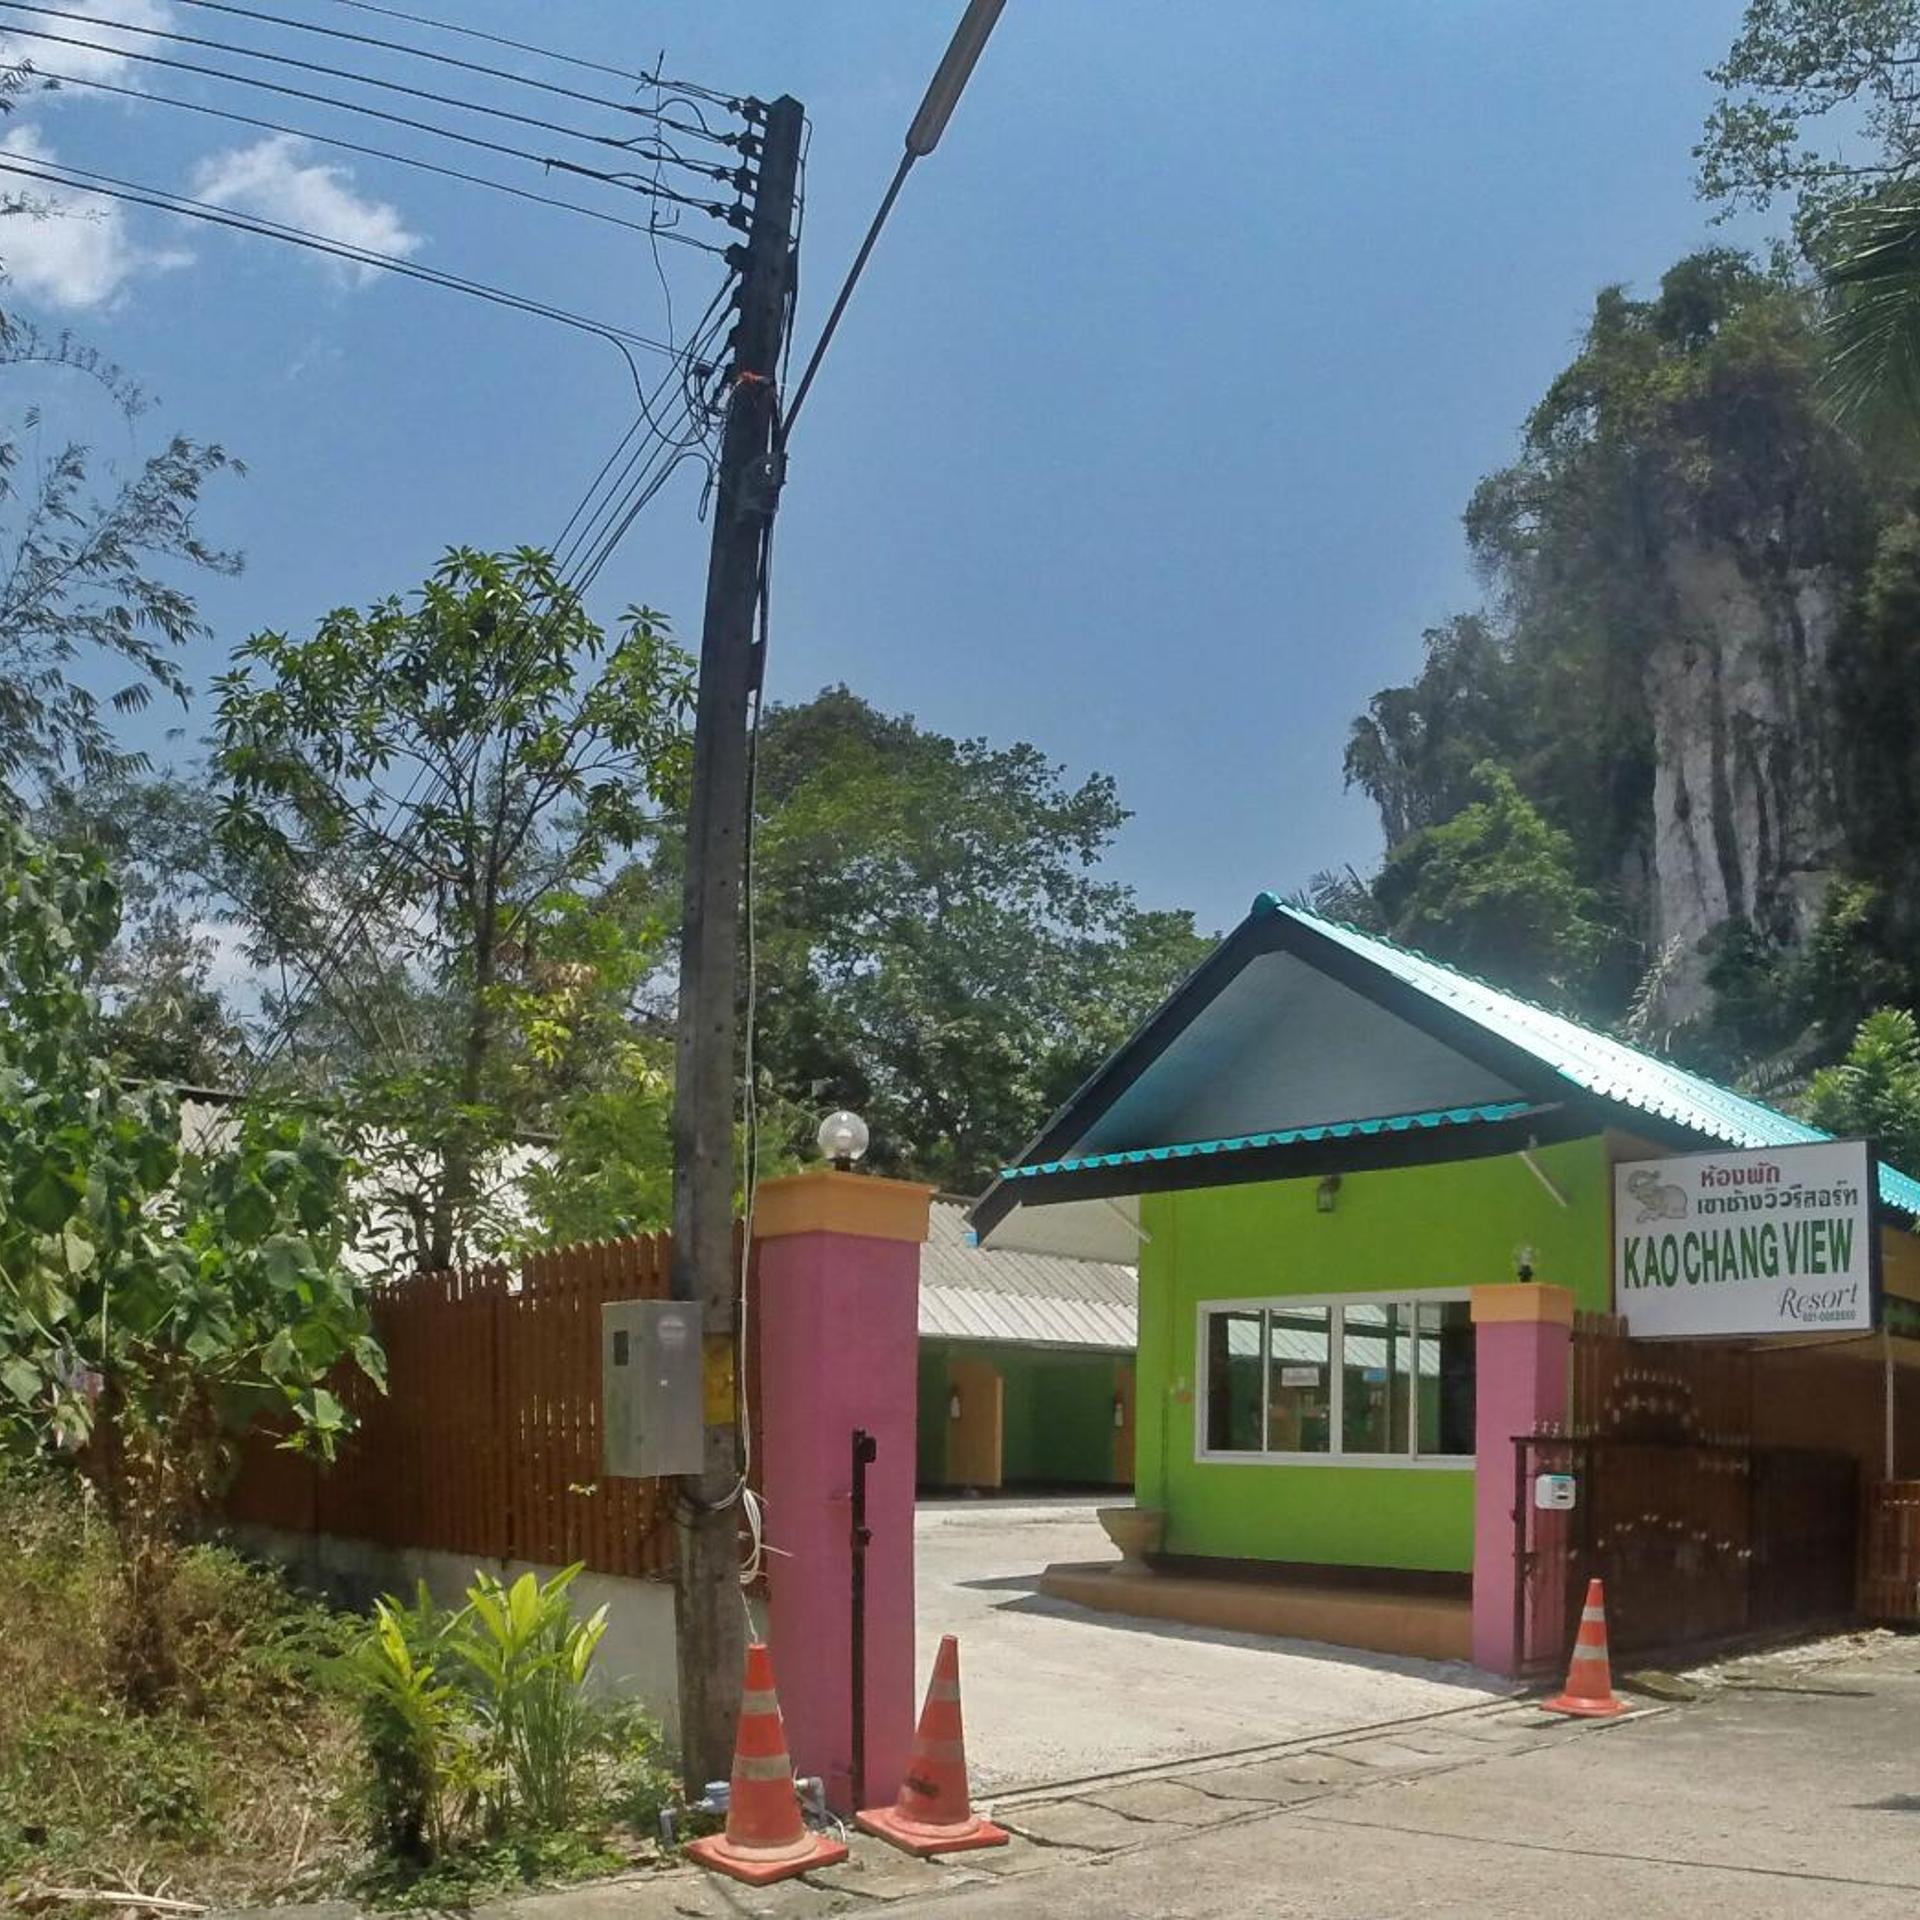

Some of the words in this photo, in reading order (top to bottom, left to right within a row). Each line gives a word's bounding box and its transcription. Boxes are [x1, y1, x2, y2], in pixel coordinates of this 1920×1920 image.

[1701, 1161, 1780, 1188] ห้องพัก
[1783, 1218, 1853, 1274] VIEW
[1780, 1282, 1857, 1318] Resort
